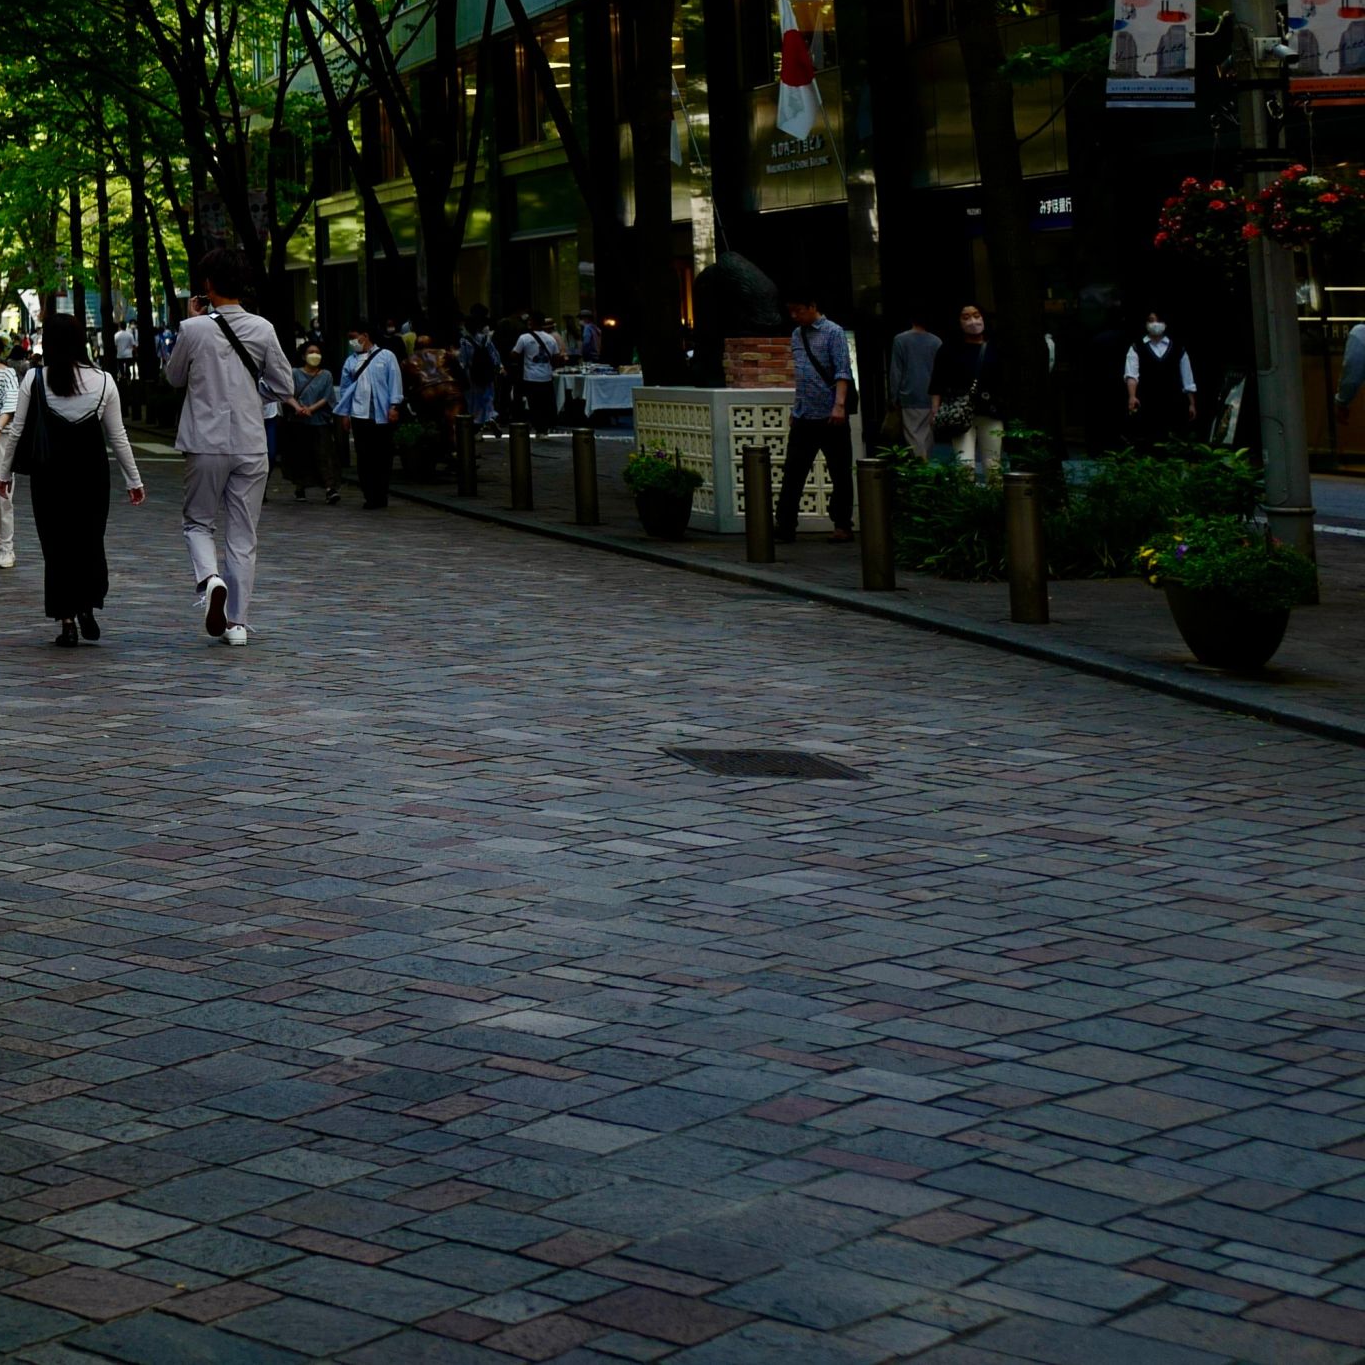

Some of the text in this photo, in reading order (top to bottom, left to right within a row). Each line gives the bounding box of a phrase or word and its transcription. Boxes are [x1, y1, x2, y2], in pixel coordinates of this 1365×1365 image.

[1039, 196, 1072, 215] みずほ銀行
